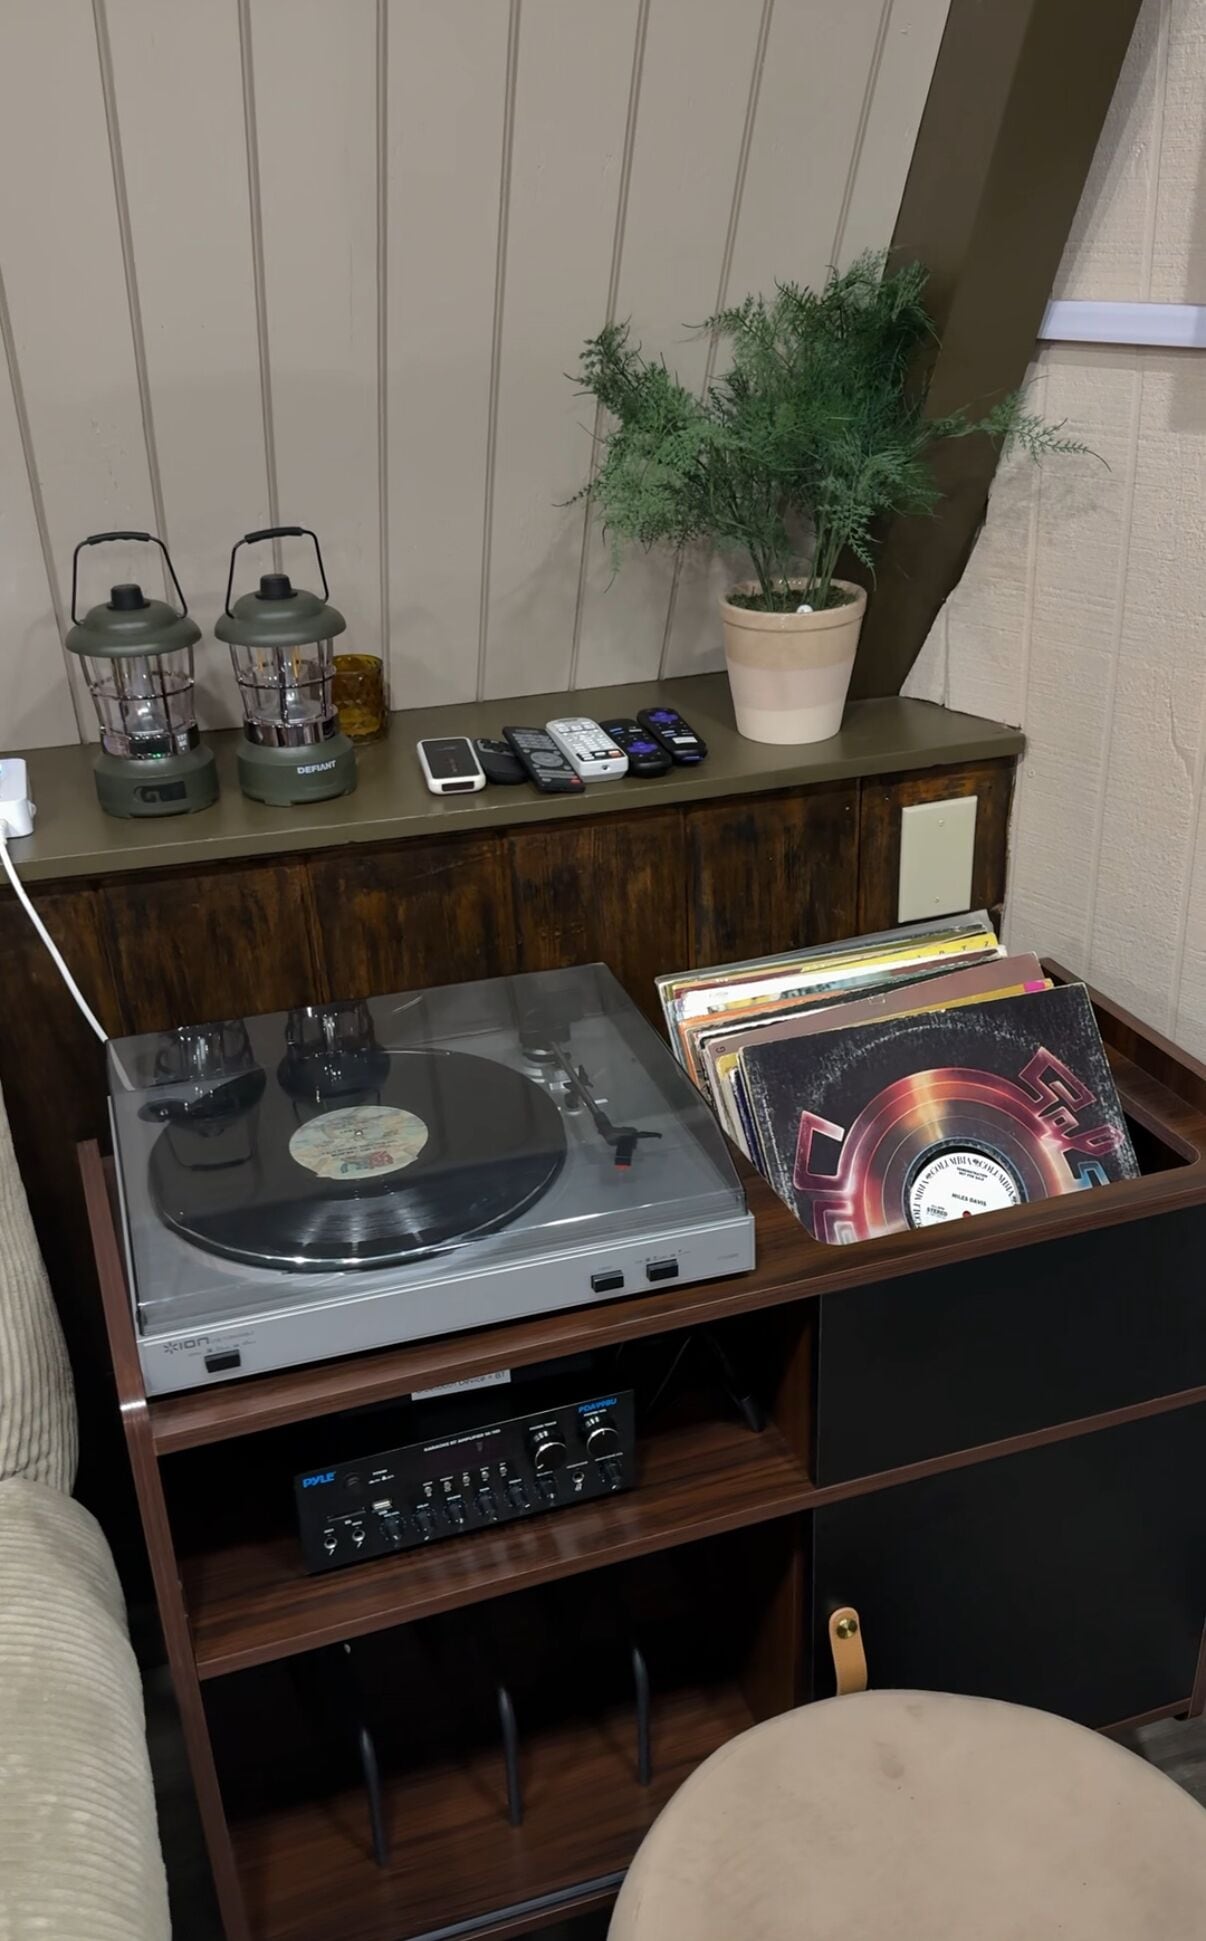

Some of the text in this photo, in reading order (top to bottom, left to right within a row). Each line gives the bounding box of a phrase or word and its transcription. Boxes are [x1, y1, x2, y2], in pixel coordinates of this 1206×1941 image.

[297, 760, 336, 774] DEFIANT
[929, 1156, 973, 1178] COLUMBIA
[979, 1160, 1015, 1198] COLUMBIA
[951, 1193, 987, 1207] MILES DAVIS
[926, 1207, 948, 1217] STEREO
[303, 1471, 336, 1488] PYLE
